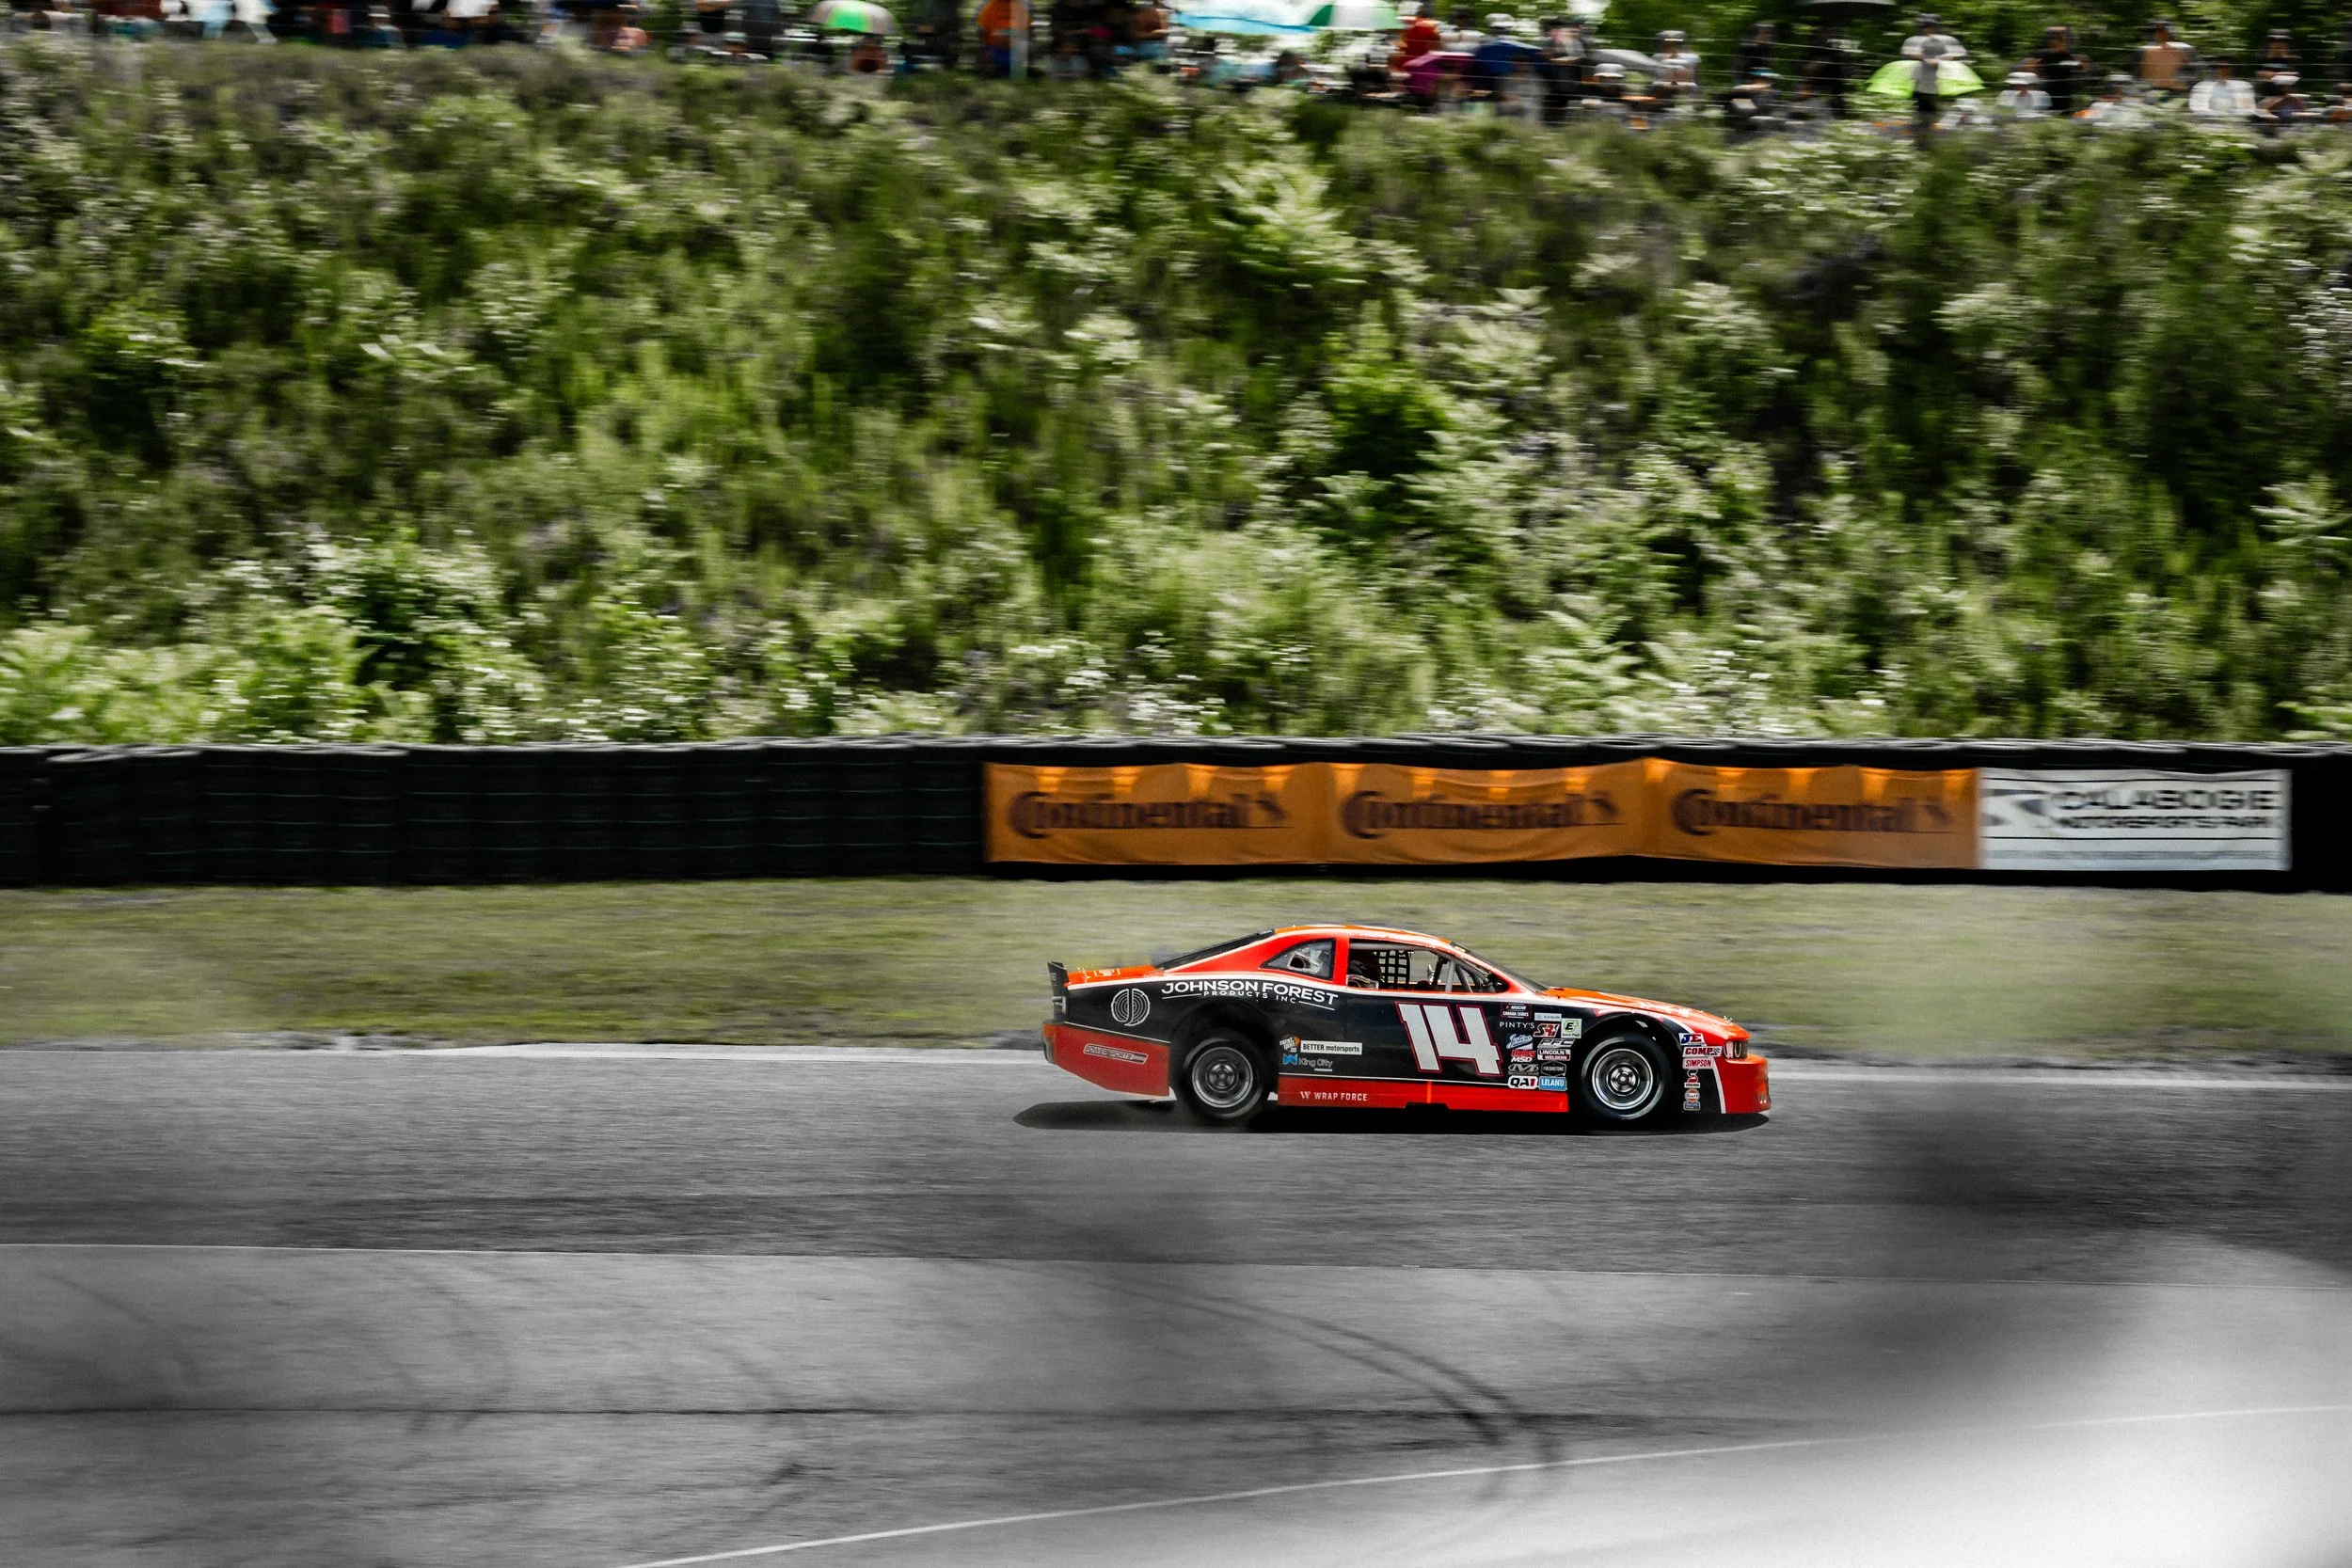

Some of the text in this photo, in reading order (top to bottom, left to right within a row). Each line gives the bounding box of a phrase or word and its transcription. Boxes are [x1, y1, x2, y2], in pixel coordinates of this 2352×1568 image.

[1161, 980, 1338, 1006] JOHNSON FOREST
[1204, 990, 1296, 1004] PRODUCTS INC
[1396, 1002, 1502, 1076] 14
[1681, 1034, 1702, 1044] JE
[1298, 1057, 1333, 1068] King City
[1685, 1059, 1711, 1068] SIMPSON
[1510, 1077, 1535, 1087] QA1
[1341, 1093, 1367, 1101] FORCE
